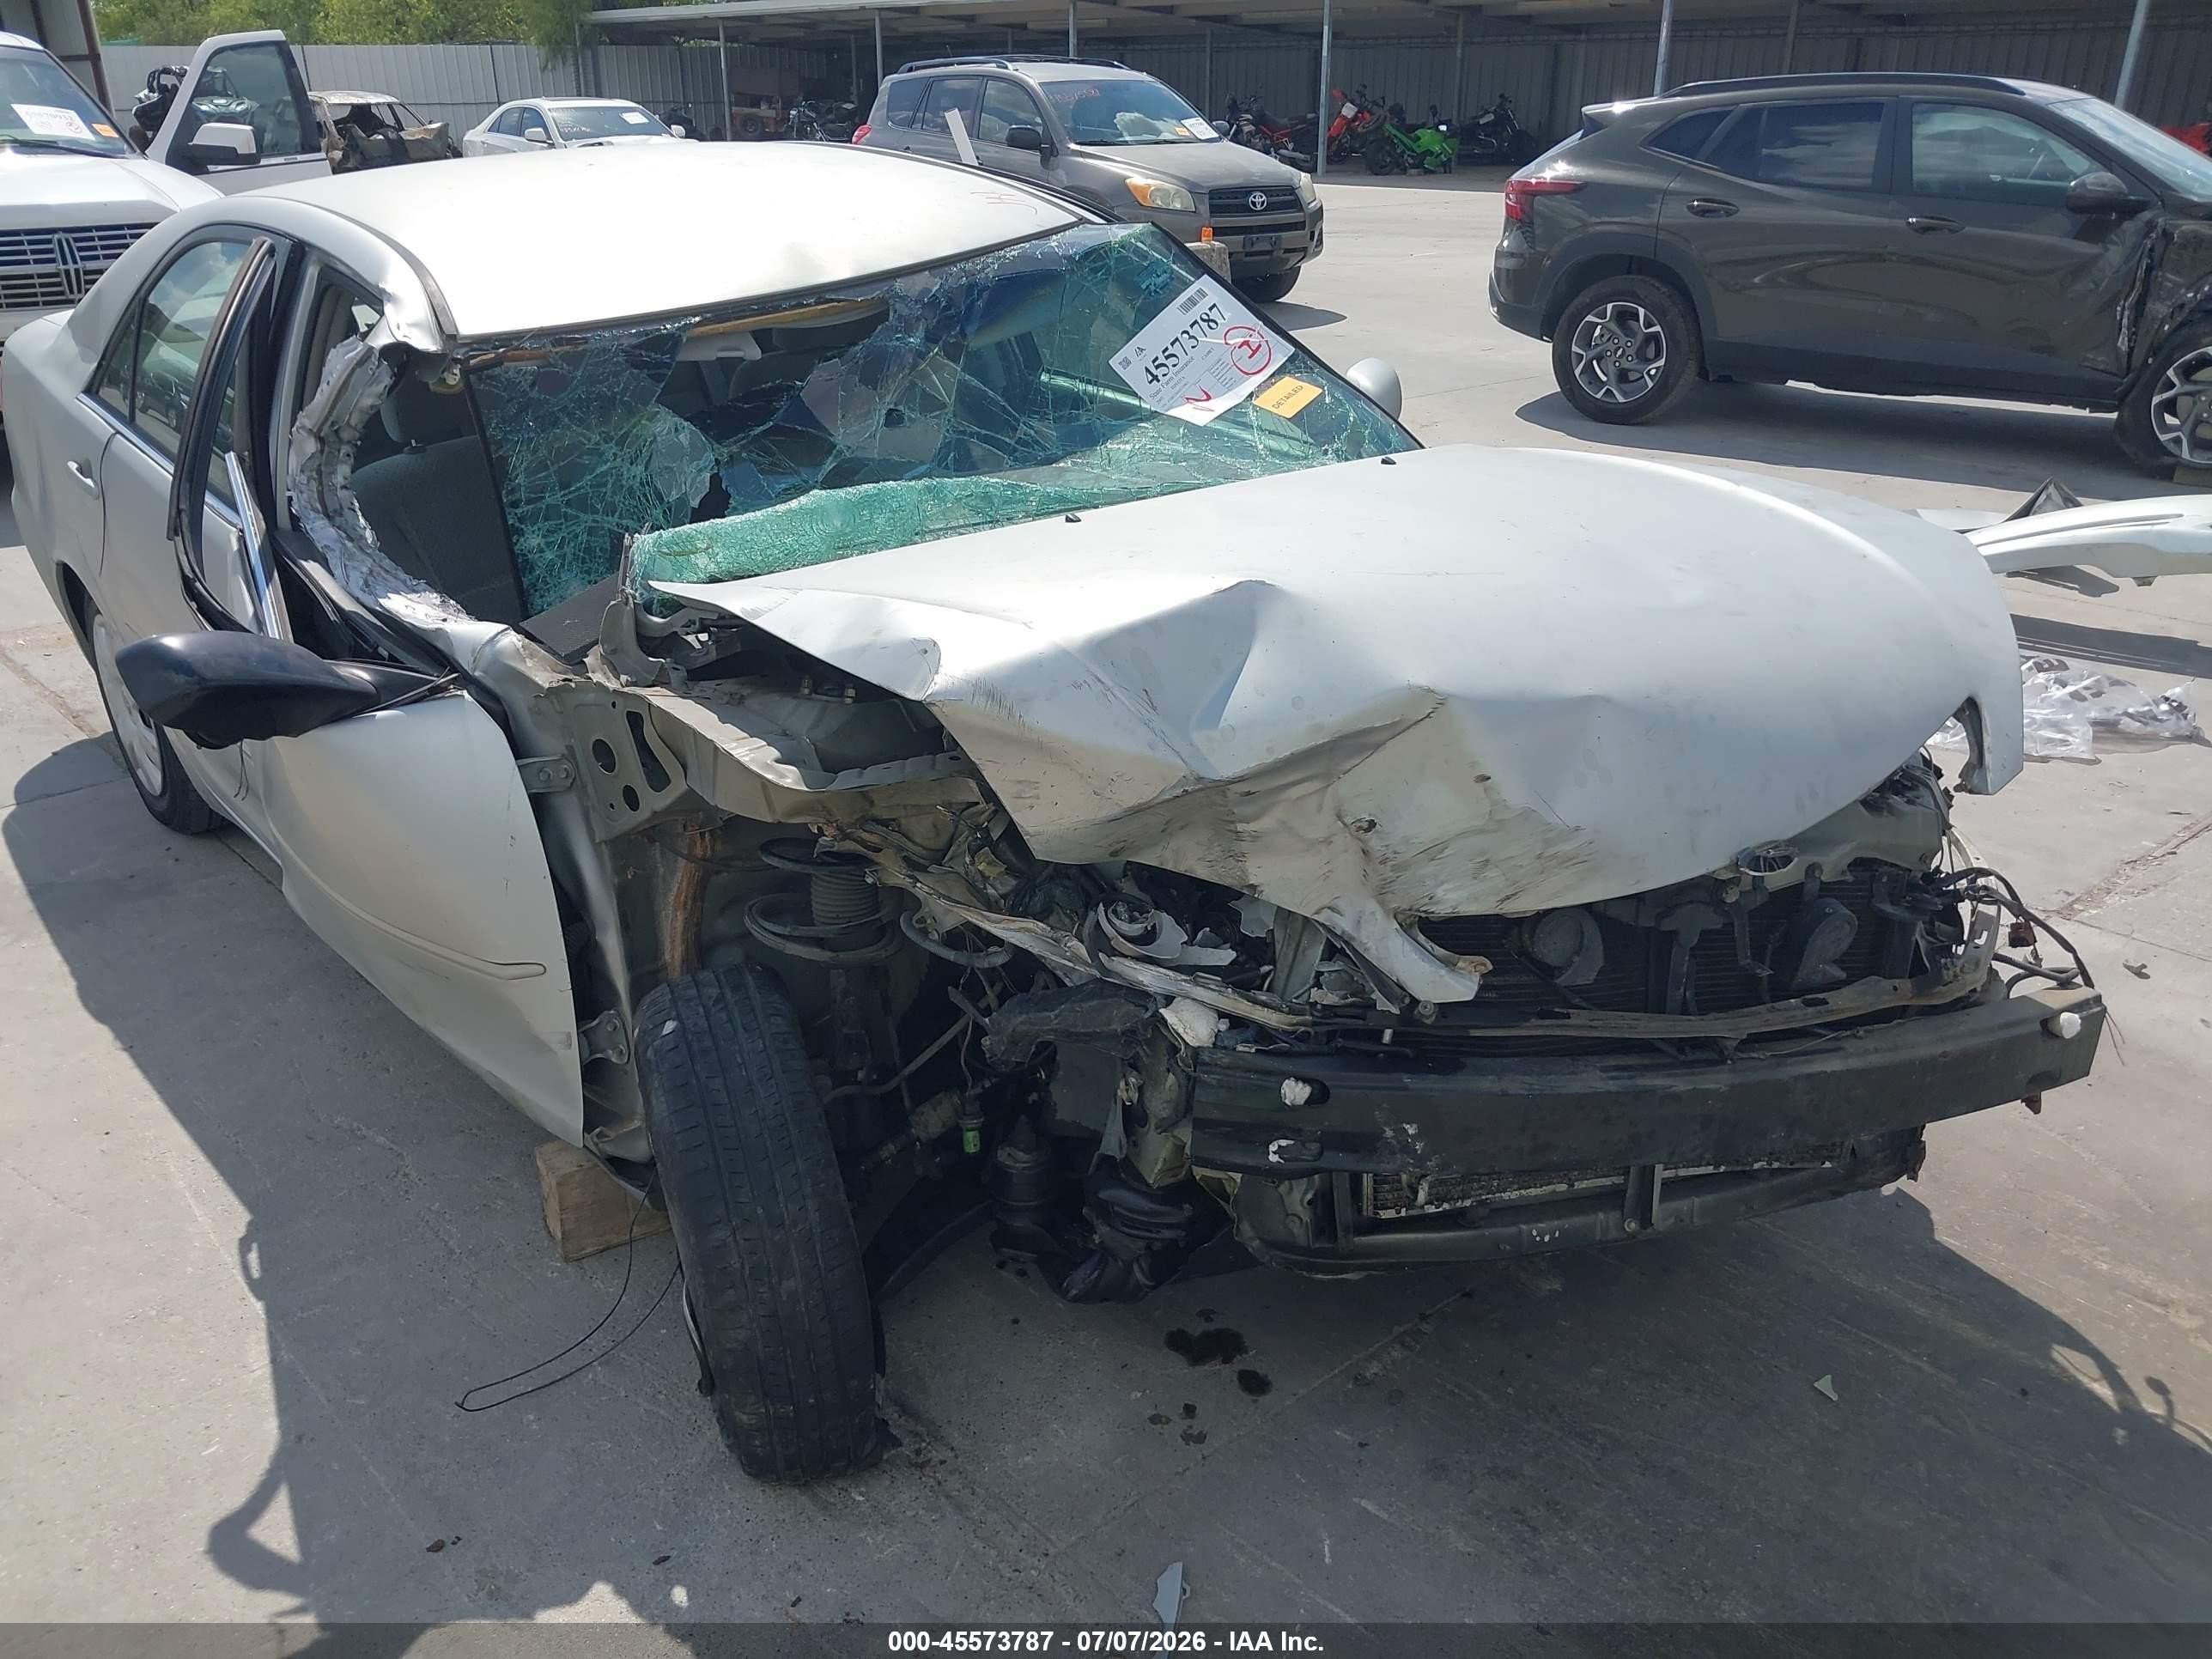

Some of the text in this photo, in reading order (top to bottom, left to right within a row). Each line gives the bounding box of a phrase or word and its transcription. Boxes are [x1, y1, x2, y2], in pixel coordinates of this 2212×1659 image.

[1143, 303, 1226, 386] 45573787
[1149, 387, 1163, 399] State
[1160, 376, 1174, 389] Farm
[1172, 356, 1195, 378] Insurance
[1271, 384, 1304, 410] DETAILED
